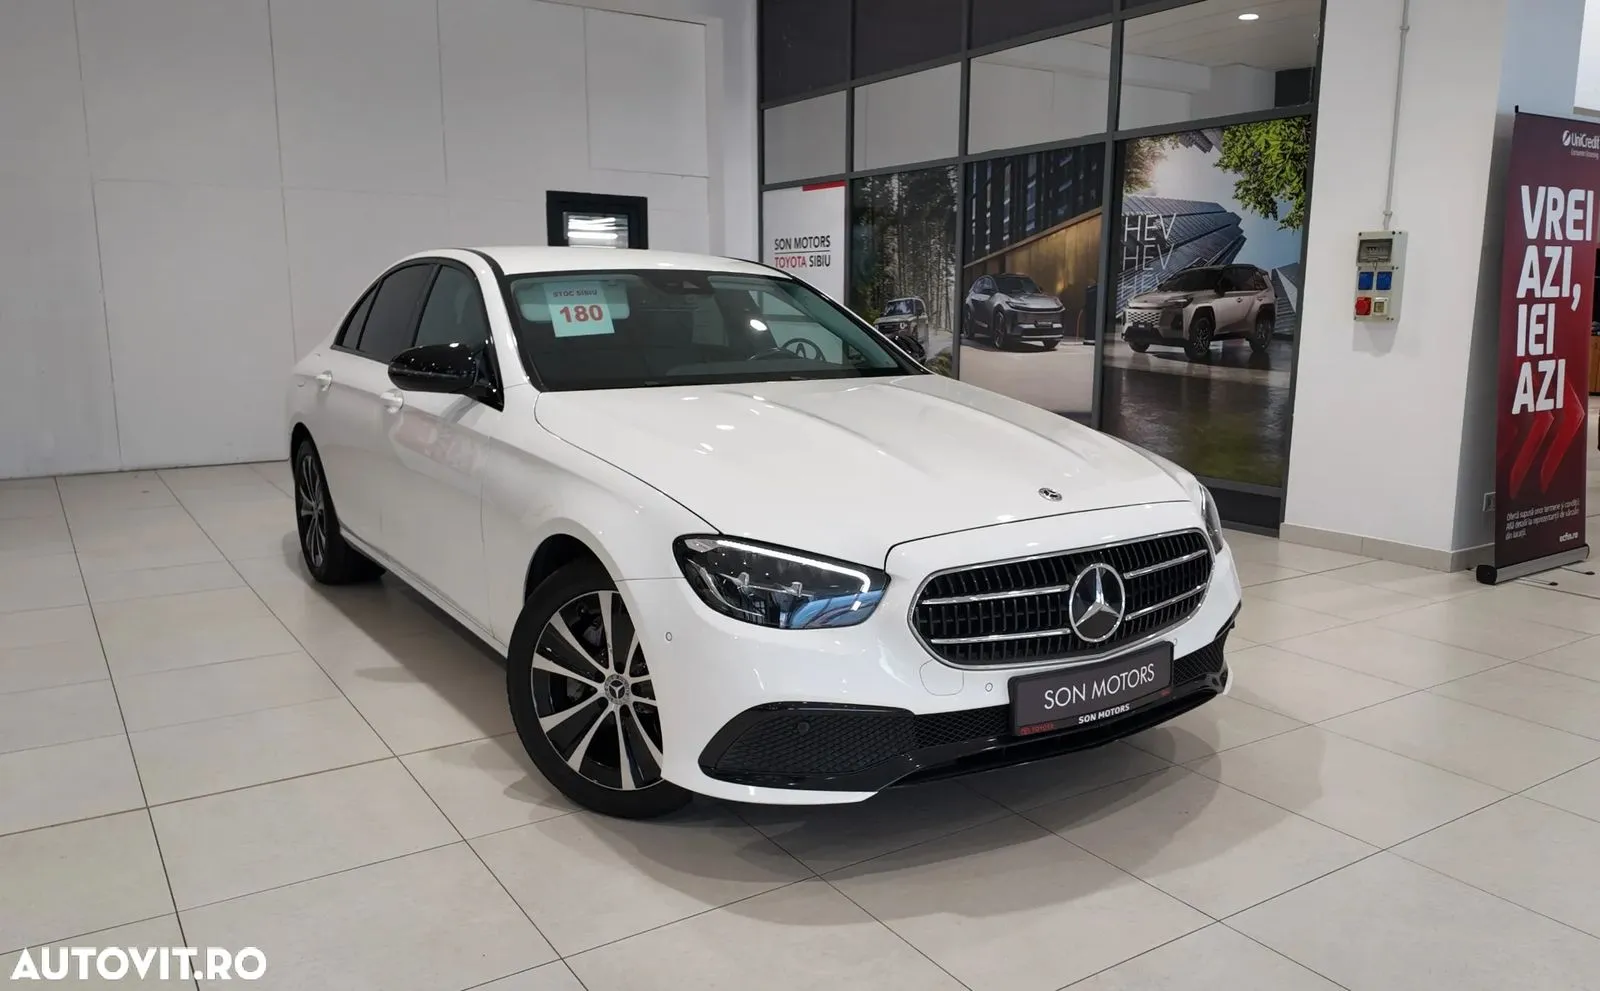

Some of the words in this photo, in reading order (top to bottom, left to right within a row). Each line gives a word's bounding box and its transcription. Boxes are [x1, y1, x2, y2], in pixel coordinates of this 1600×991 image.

[1124, 213, 1176, 242] HEV
[1521, 185, 1594, 241] VREI
[774, 238, 792, 250] SON
[794, 235, 831, 249] MOTORS
[1123, 243, 1175, 271] HEV
[774, 256, 807, 268] TOYOTA
[809, 255, 831, 267] SIBIU
[1516, 245, 1581, 311] AZI,
[560, 304, 603, 323] 180
[1517, 304, 1556, 357] IEI
[1512, 359, 1566, 415] AZI
[1044, 683, 1086, 710] SON
[1091, 663, 1155, 700] MOTORS
[1078, 710, 1097, 724] SON
[1099, 703, 1131, 719] MOTORS
